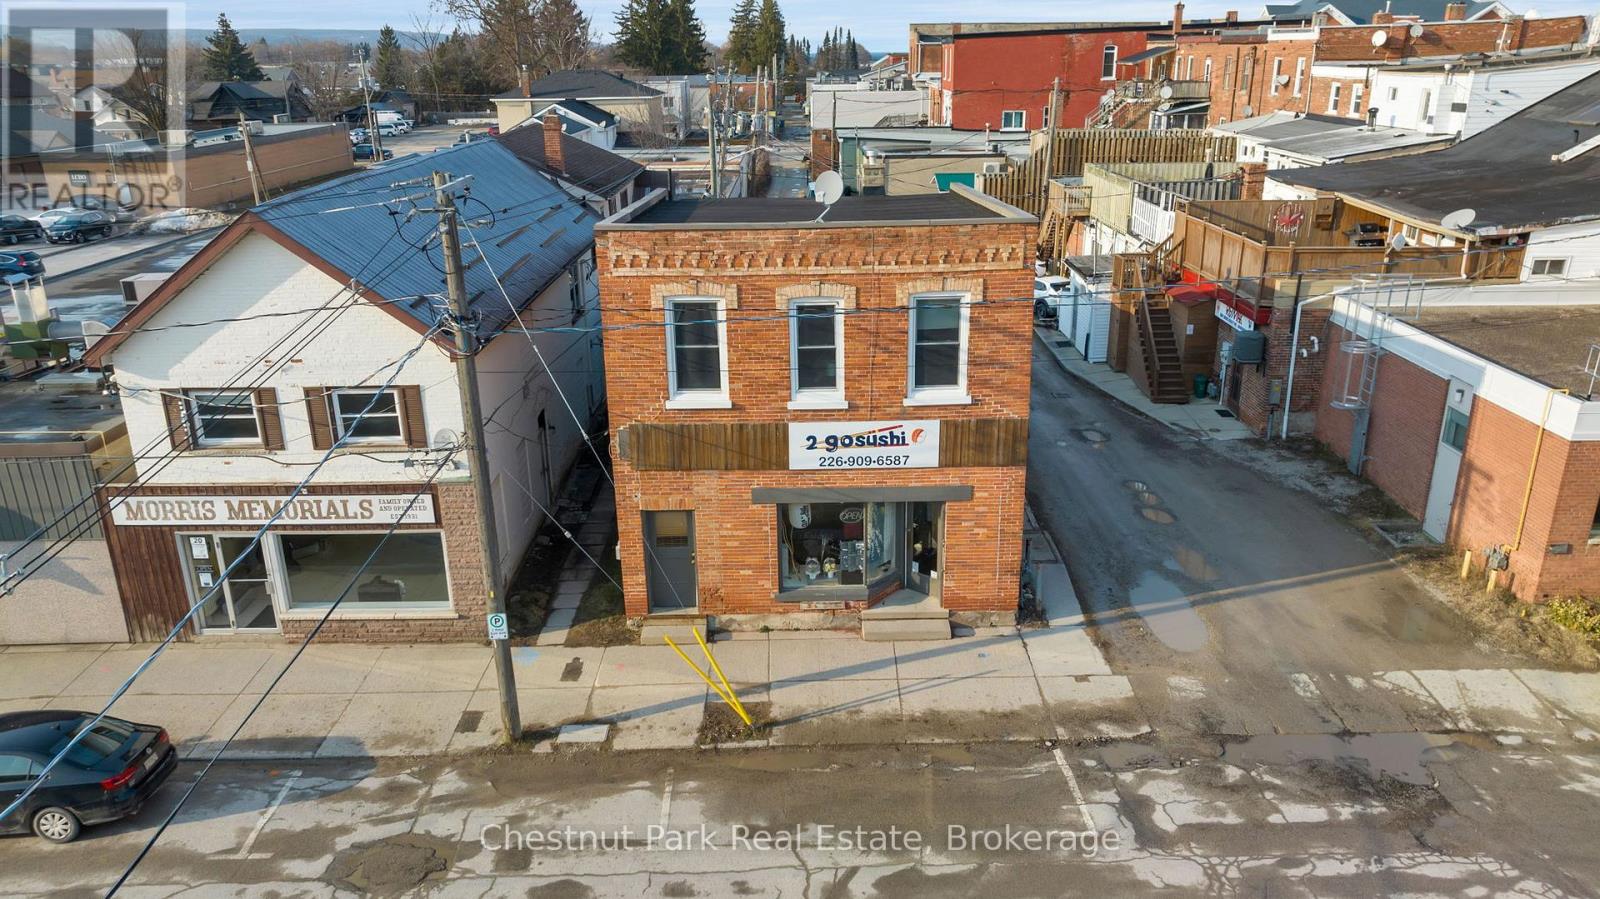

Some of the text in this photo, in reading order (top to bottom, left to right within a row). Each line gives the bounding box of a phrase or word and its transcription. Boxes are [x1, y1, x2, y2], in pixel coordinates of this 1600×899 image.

[805, 435, 817, 450] 2
[124, 498, 375, 521] MORRIS MEMORIALS
